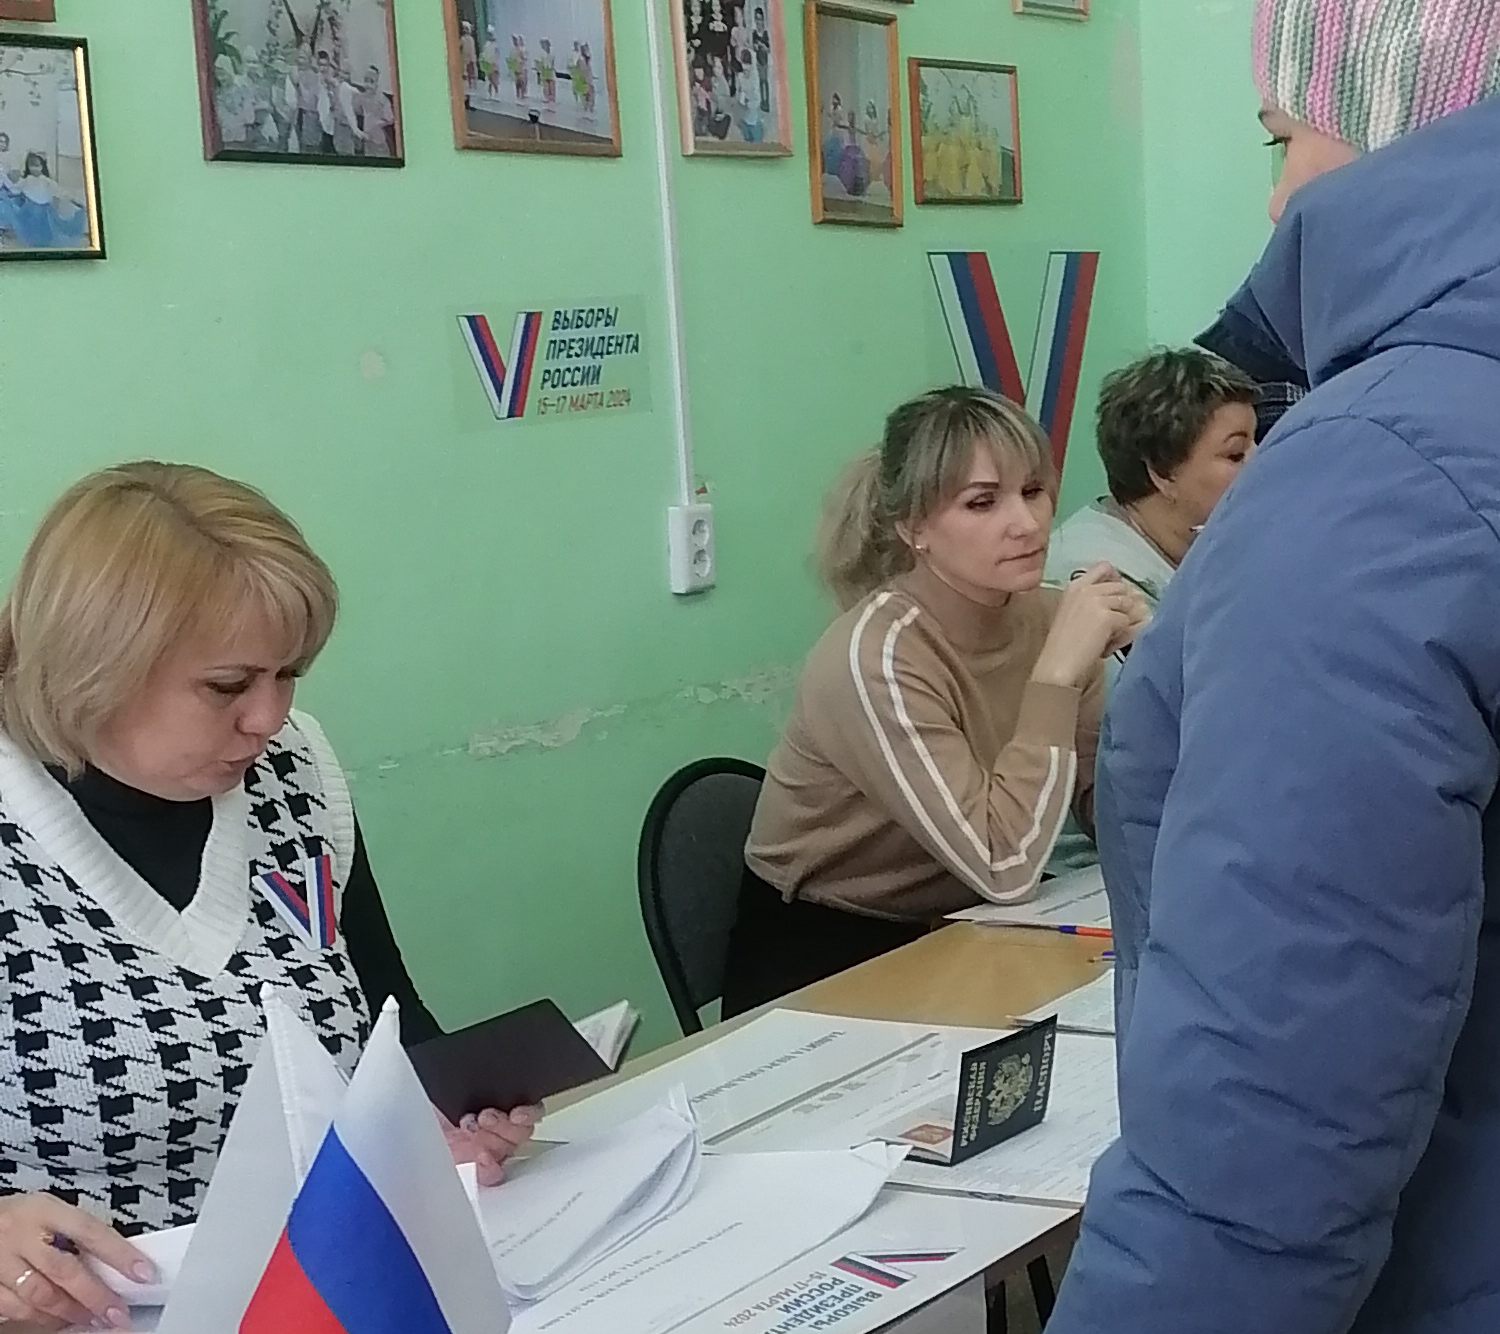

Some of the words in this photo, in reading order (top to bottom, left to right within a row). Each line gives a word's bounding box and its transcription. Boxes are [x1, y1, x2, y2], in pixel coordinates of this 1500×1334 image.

[551, 307, 619, 331] ВЫБОРЫ
[545, 333, 640, 360] ПРЕЗИДЕНТА
[540, 365, 602, 390] РОССИИ
[568, 392, 604, 412] МАРТА
[606, 388, 632, 408] 2024
[1032, 1029, 1053, 1113] ПАСПОРТ
[752, 1287, 797, 1312] МАРТА
[776, 1276, 846, 1314] РОССИИ
[722, 1308, 758, 1328] 2024
[807, 1290, 883, 1331] ВЫБОРЫ
